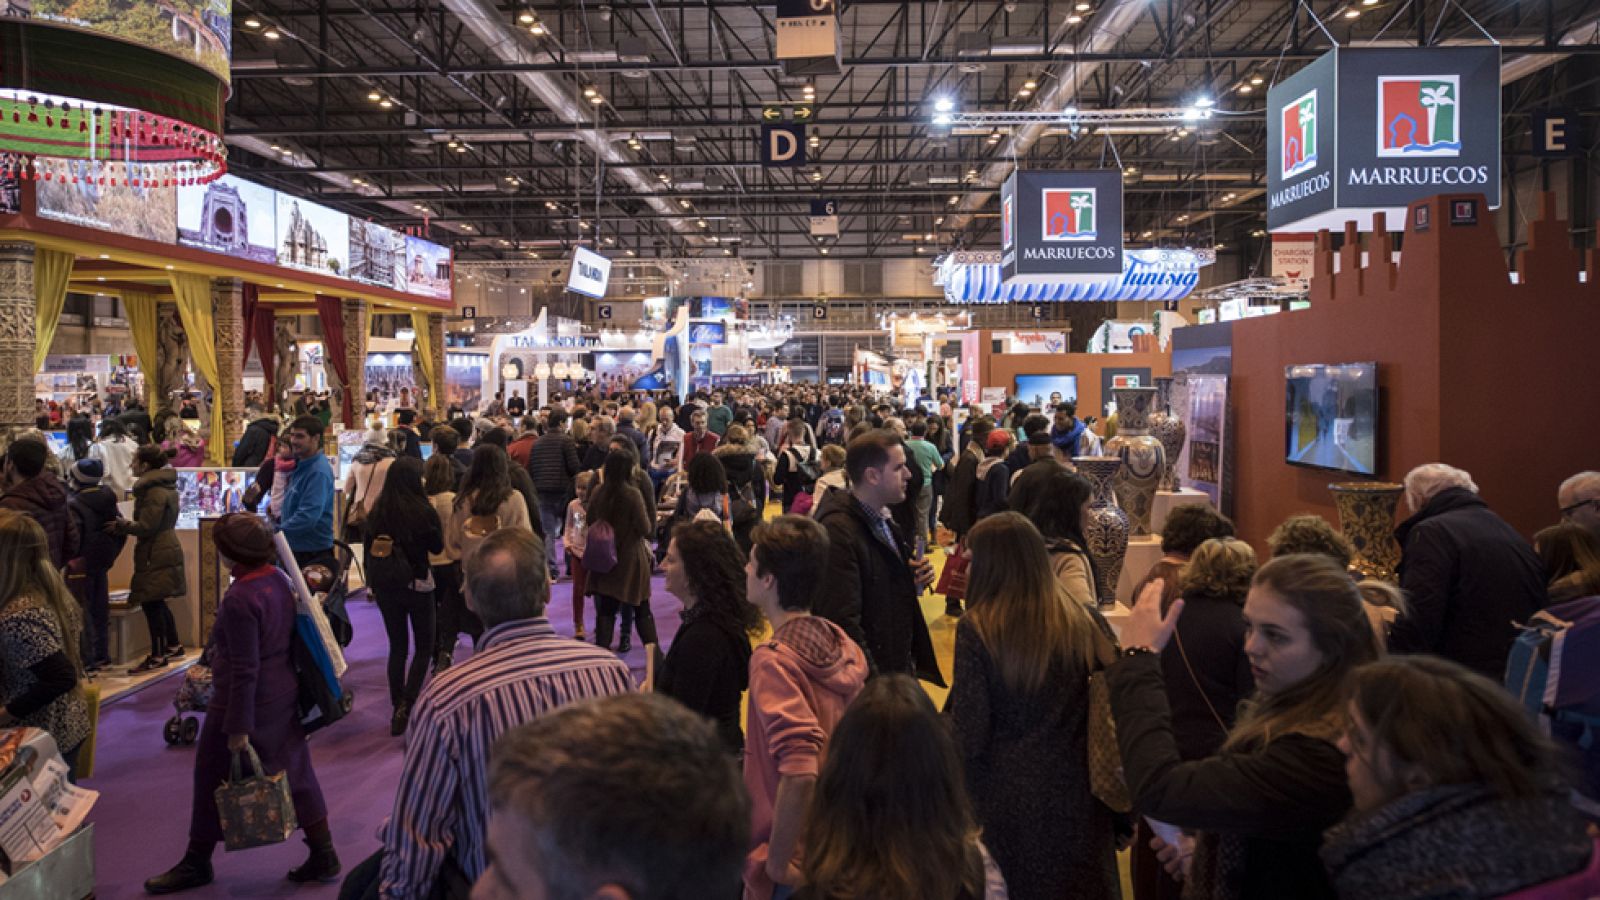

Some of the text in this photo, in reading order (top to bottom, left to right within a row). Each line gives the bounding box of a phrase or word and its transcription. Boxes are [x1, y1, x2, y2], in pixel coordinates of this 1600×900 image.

[1545, 118, 1567, 150] E
[769, 129, 798, 161] D
[1348, 165, 1489, 186] MARRUECOS
[1270, 171, 1331, 210] MARRUECOS
[825, 201, 834, 215] 6
[1023, 246, 1116, 259] MARRUECOS
[1121, 254, 1198, 287] Tunisia
[601, 307, 610, 318] C
[815, 307, 824, 318] D
